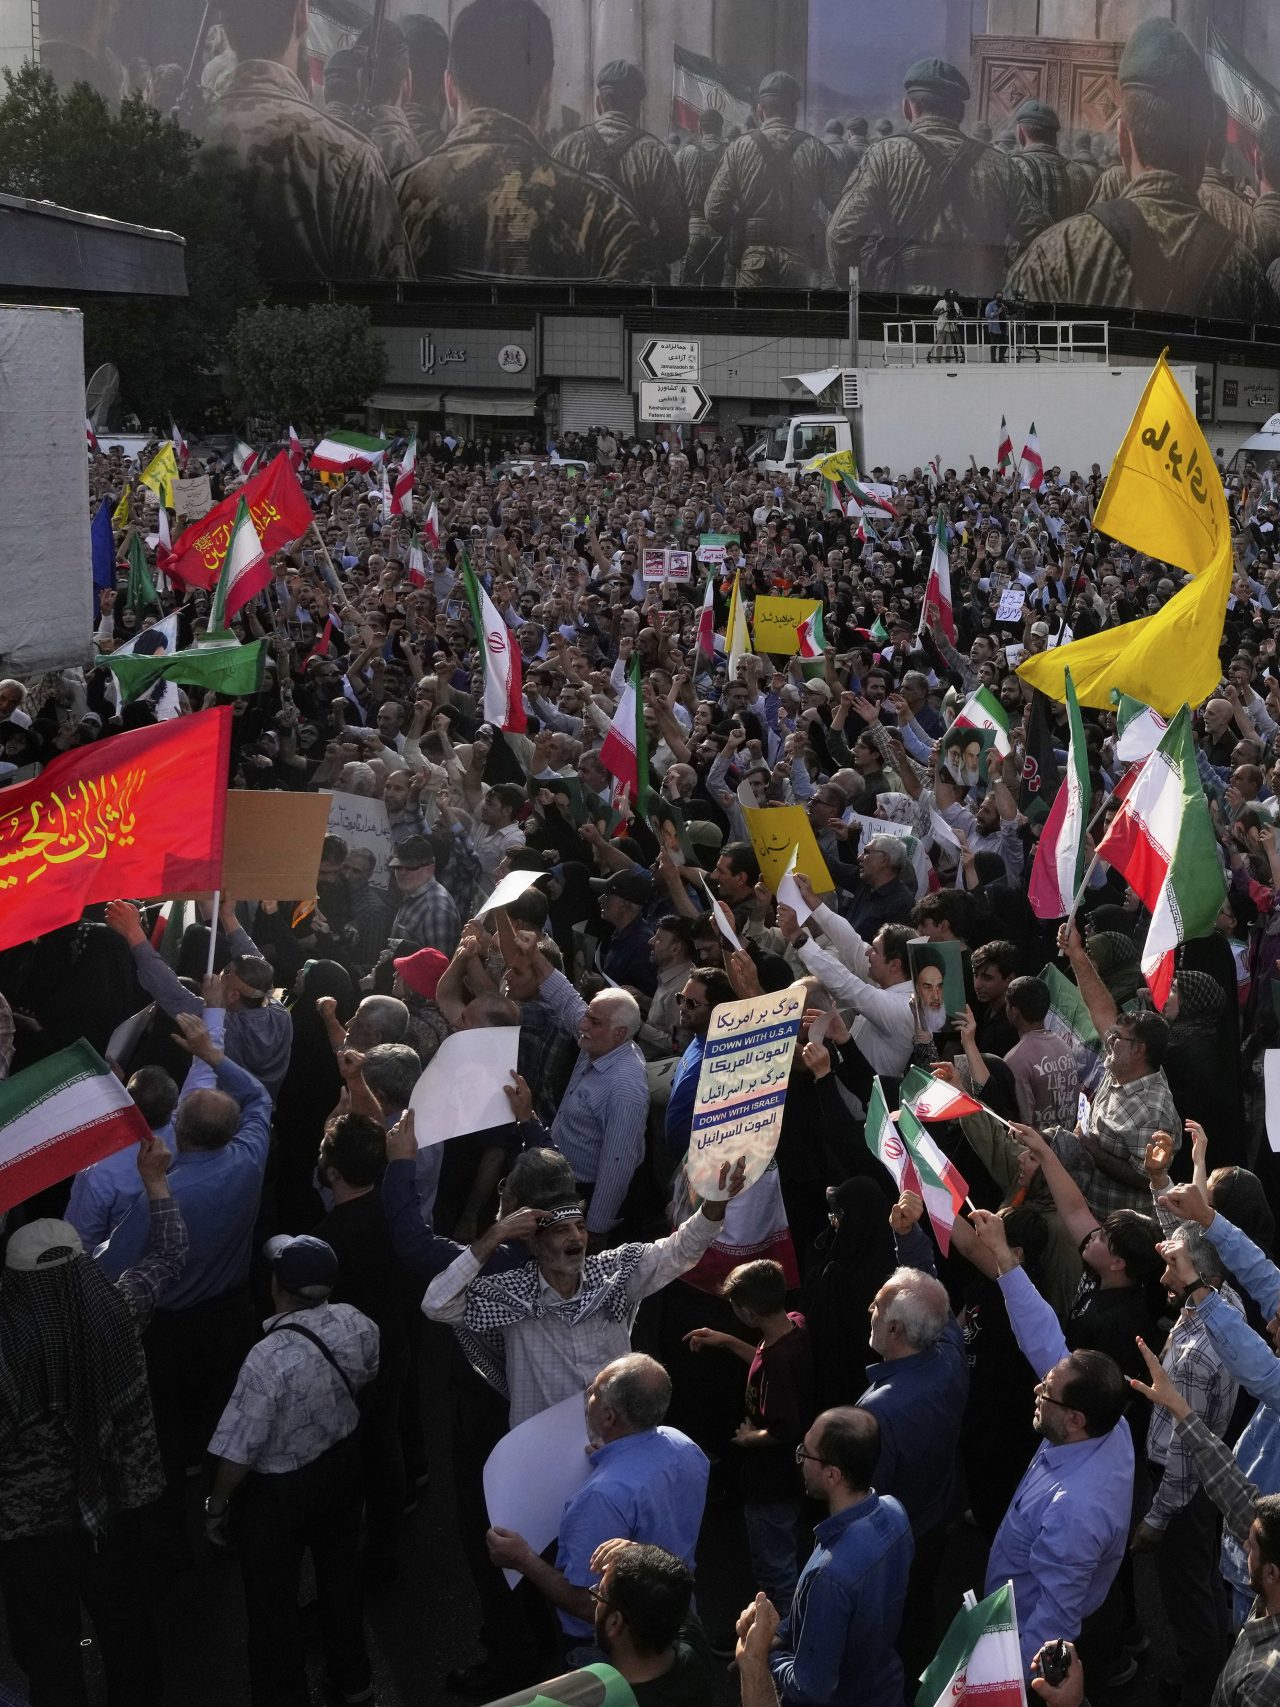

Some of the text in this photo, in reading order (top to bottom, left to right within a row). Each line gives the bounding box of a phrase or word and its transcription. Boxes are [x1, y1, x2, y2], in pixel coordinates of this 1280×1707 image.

[440, 348, 466, 365] کفش
[668, 354, 686, 362] آزادی
[761, 612, 773, 623] شد
[717, 998, 799, 1031] مرگ بر امریکا
[711, 1026, 793, 1054] DOWN WITH U.S.A
[709, 1042, 789, 1074] الموت لامریکا
[1034, 1054, 1077, 1077] You Giv
[701, 1068, 786, 1105] مرگ بر اسرائیل
[1047, 1073, 1066, 1091] Life
[698, 1097, 780, 1126] DOWN WITH ISRAEL
[1034, 1106, 1056, 1122] You
[744, 1112, 776, 1133] الموت
[553, 1208, 582, 1220] حسین
